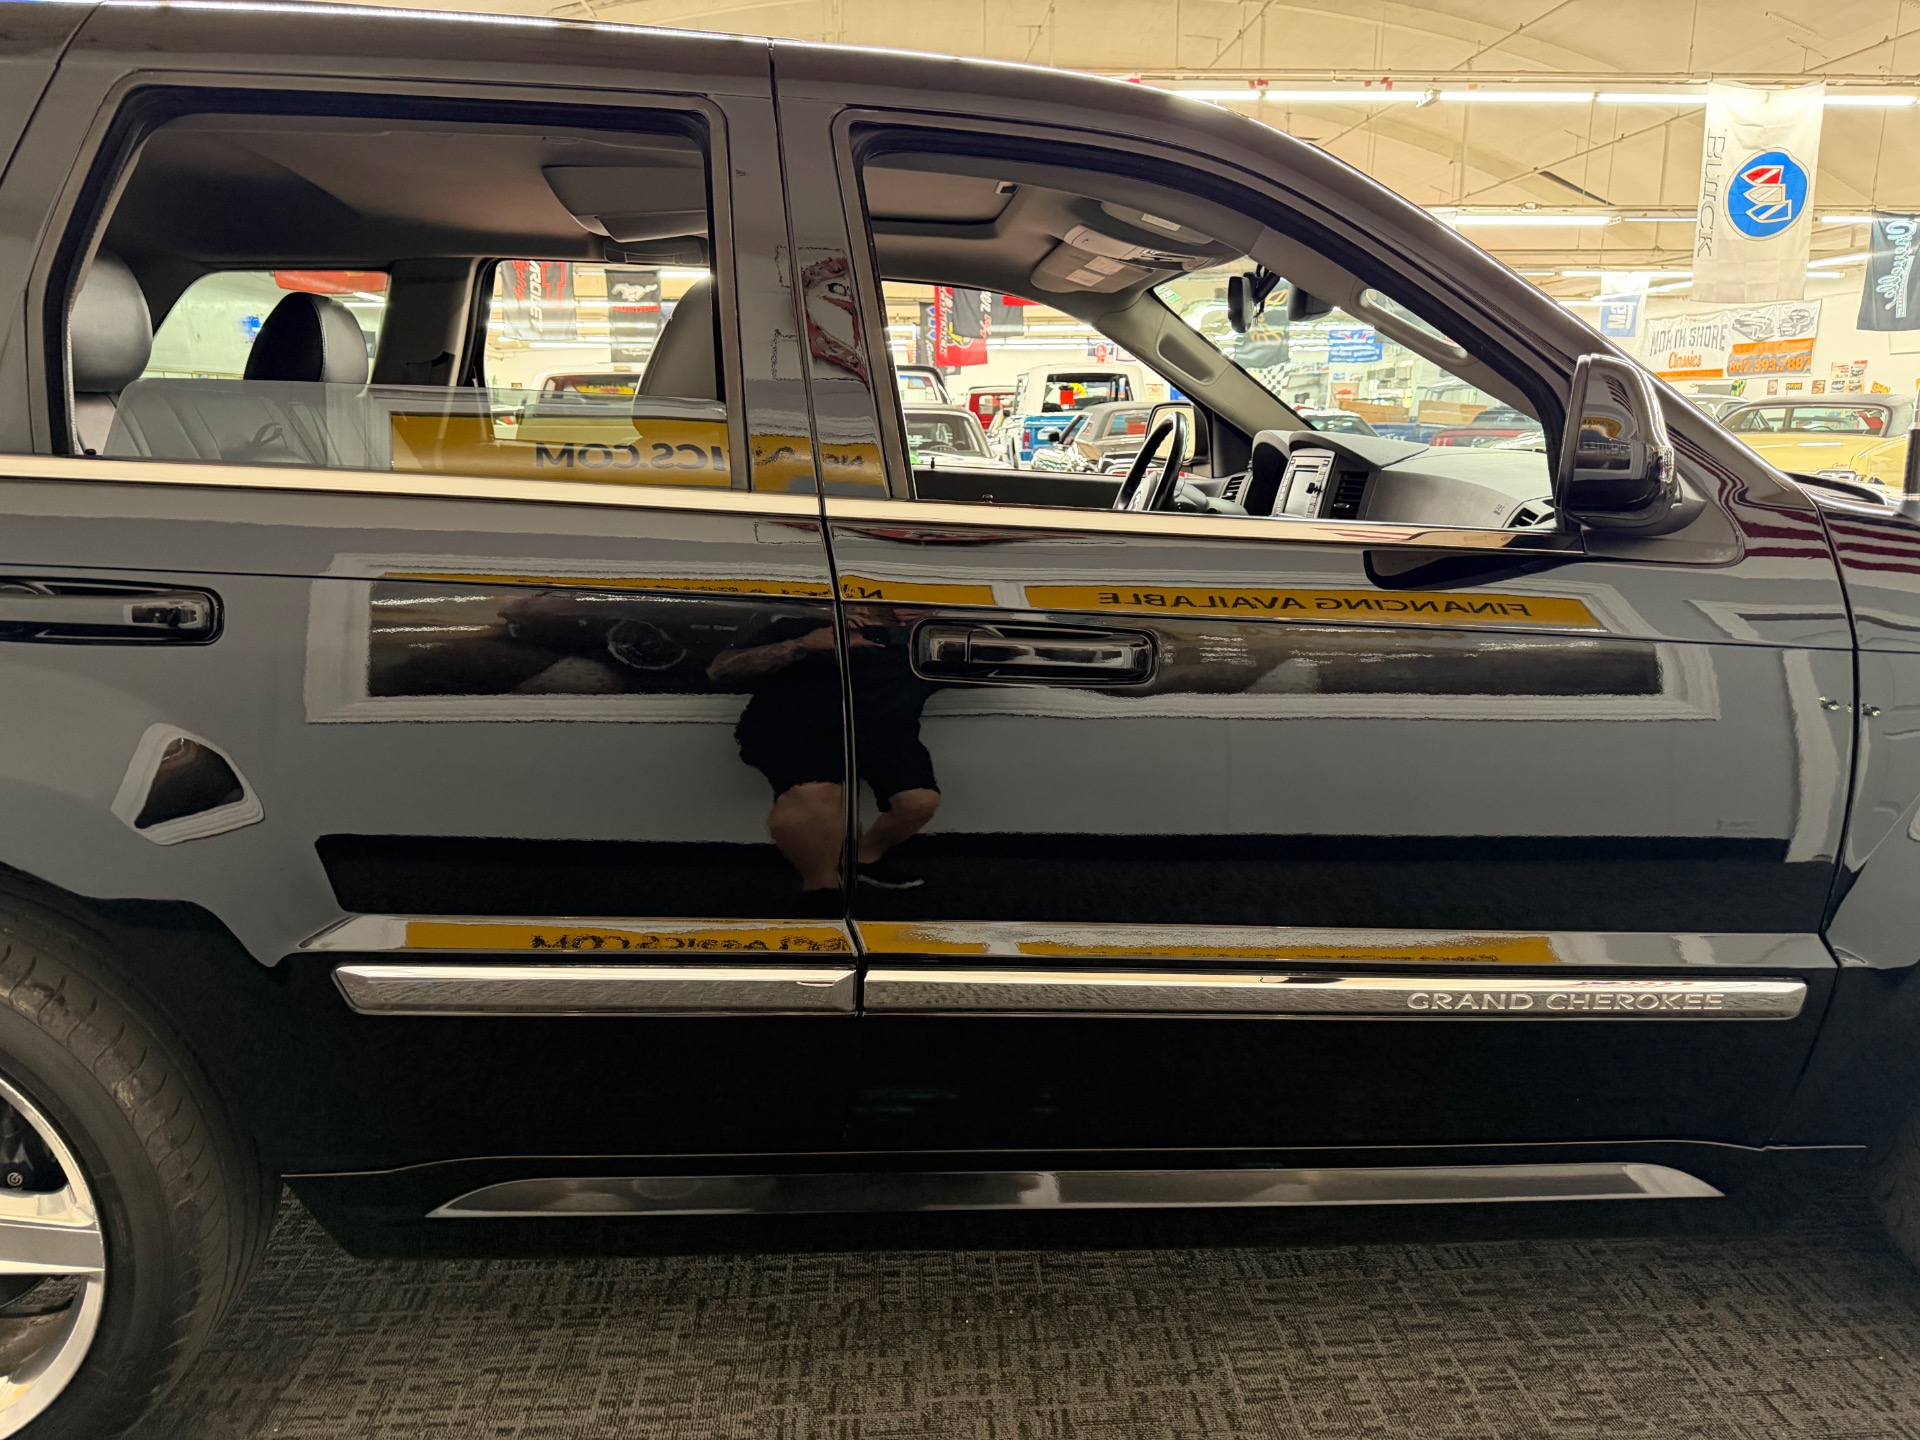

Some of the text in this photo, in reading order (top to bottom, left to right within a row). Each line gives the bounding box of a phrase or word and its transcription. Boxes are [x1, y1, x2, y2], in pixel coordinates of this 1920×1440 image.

[1697, 127, 1728, 258] BUICK
[1649, 328, 1685, 357] NORTH
[1688, 324, 1728, 352] SHORE
[1668, 350, 1702, 370] Classics
[1728, 354, 1811, 374] 847.393.7887
[1406, 992, 1724, 1011] GRAND CHEROKEE
